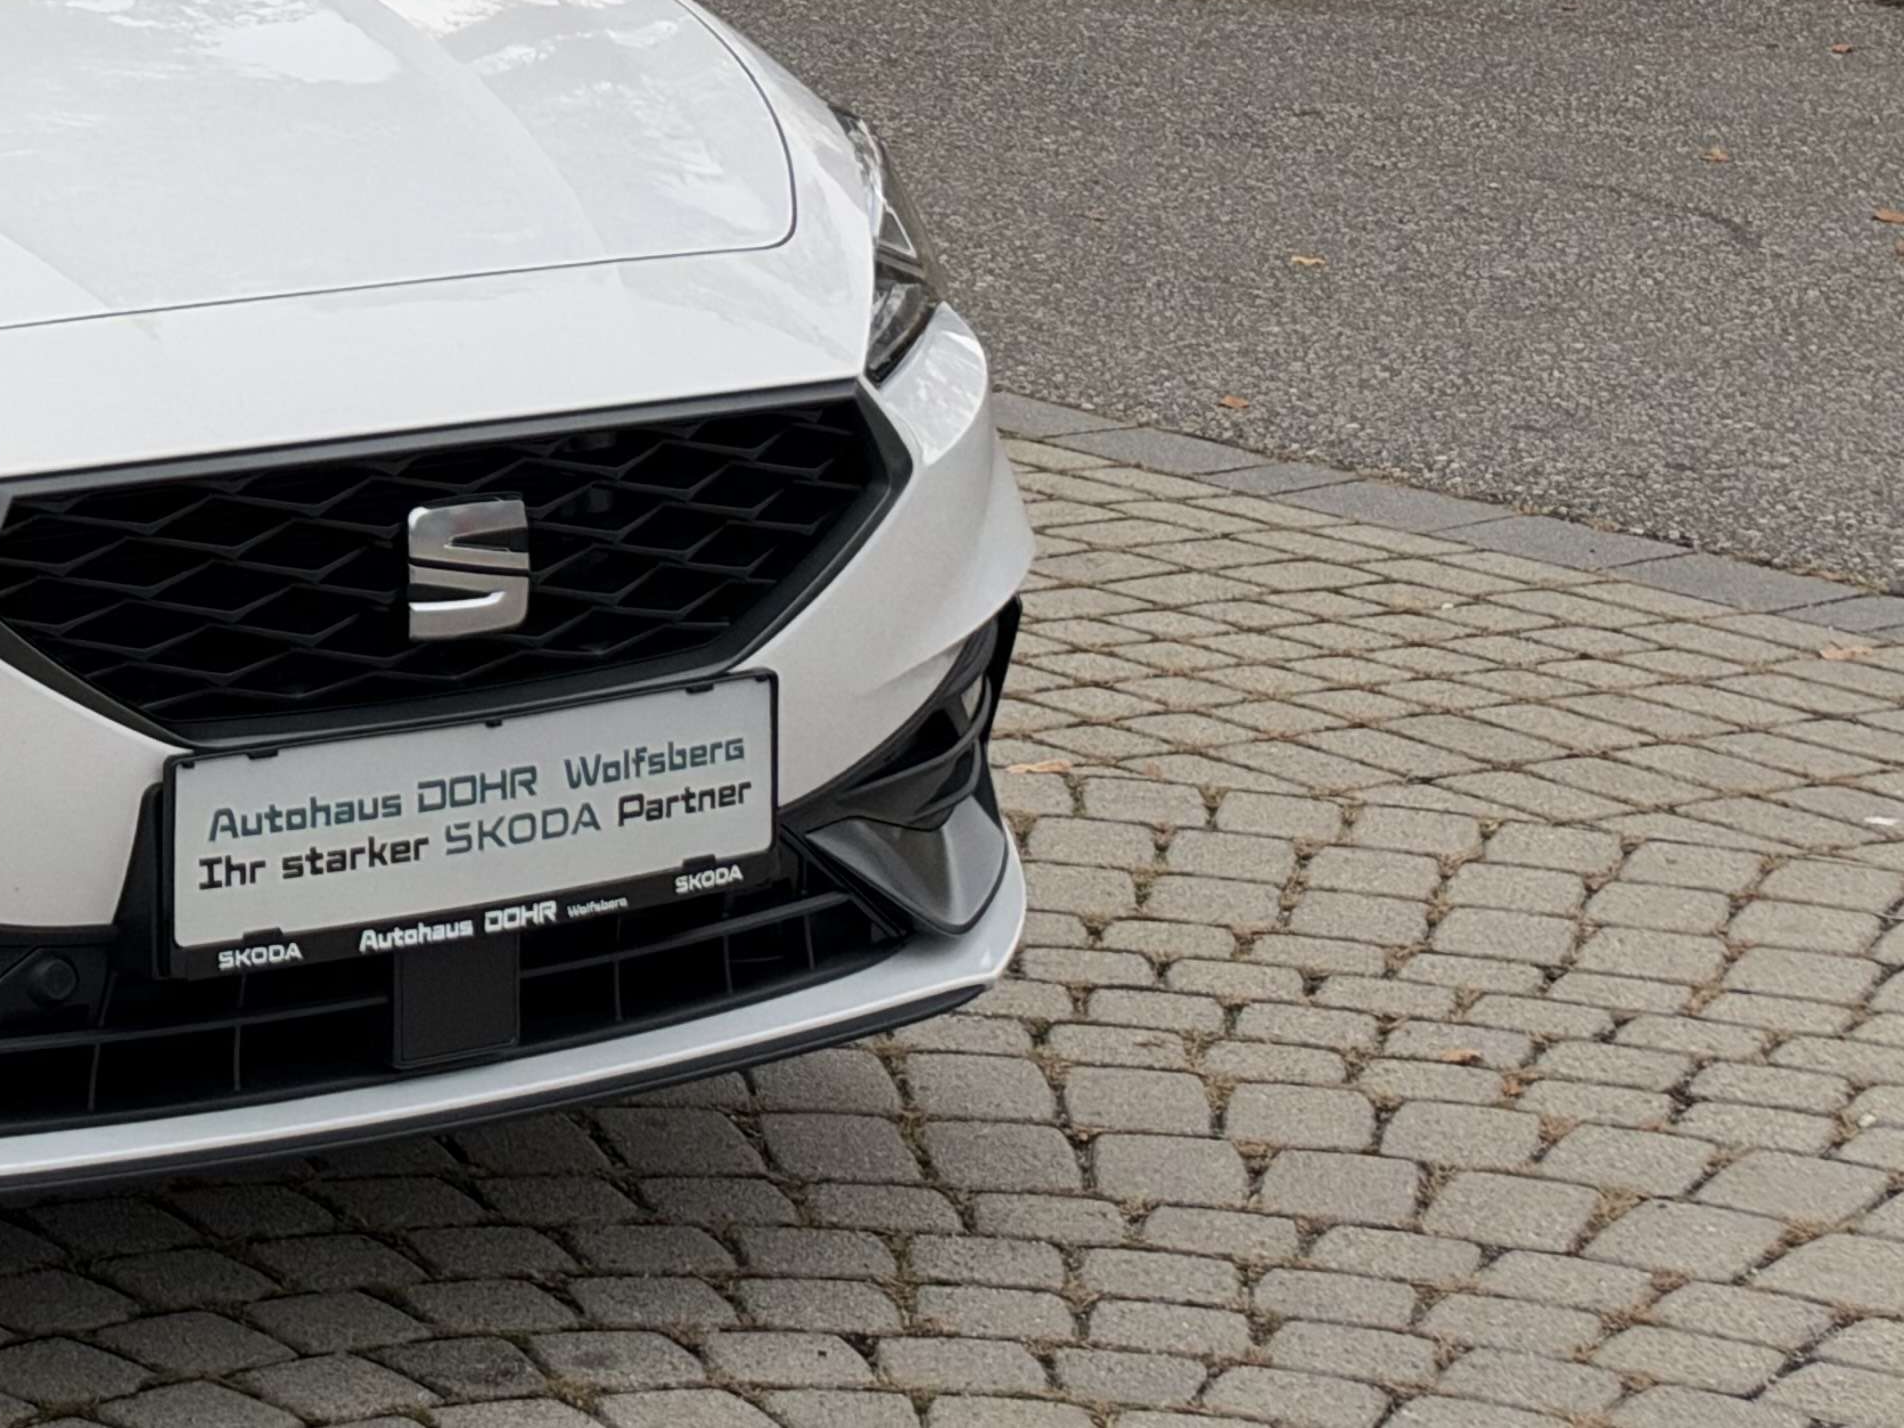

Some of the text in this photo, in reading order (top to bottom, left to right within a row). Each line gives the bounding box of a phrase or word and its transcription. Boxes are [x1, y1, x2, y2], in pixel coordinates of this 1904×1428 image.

[198, 855, 266, 891] Ihr
[282, 836, 430, 882] starker
[617, 778, 753, 827] Partner
[208, 737, 746, 843] Autohaus DOHR Wolfsberg
[359, 919, 474, 953] Autohaus
[484, 900, 558, 933] DOHR
